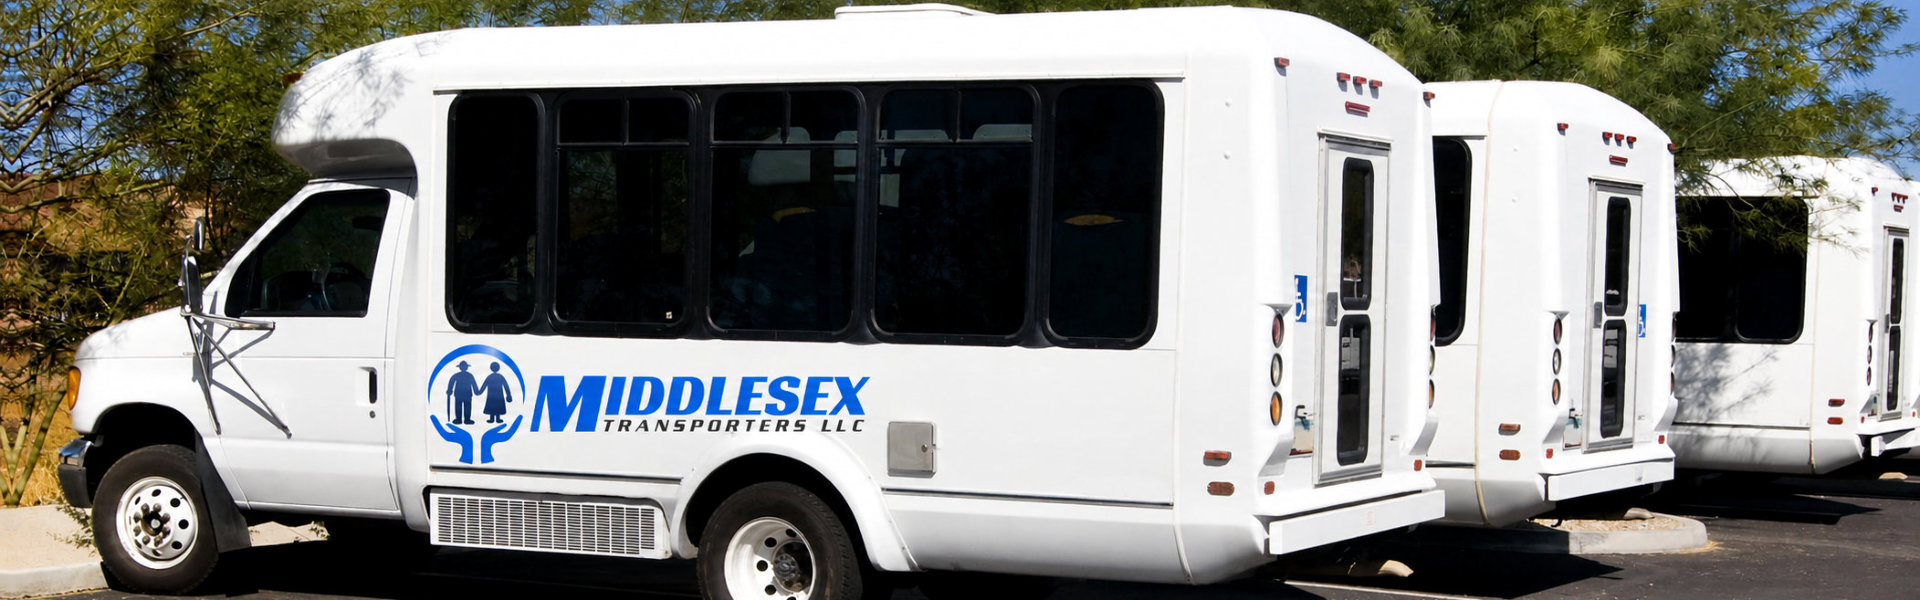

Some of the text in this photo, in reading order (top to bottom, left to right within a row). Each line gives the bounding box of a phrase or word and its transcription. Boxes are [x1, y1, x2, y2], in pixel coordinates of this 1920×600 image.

[530, 375, 871, 432] MIDDLESEX
[603, 419, 865, 432] TRANSPORTERS LLC
